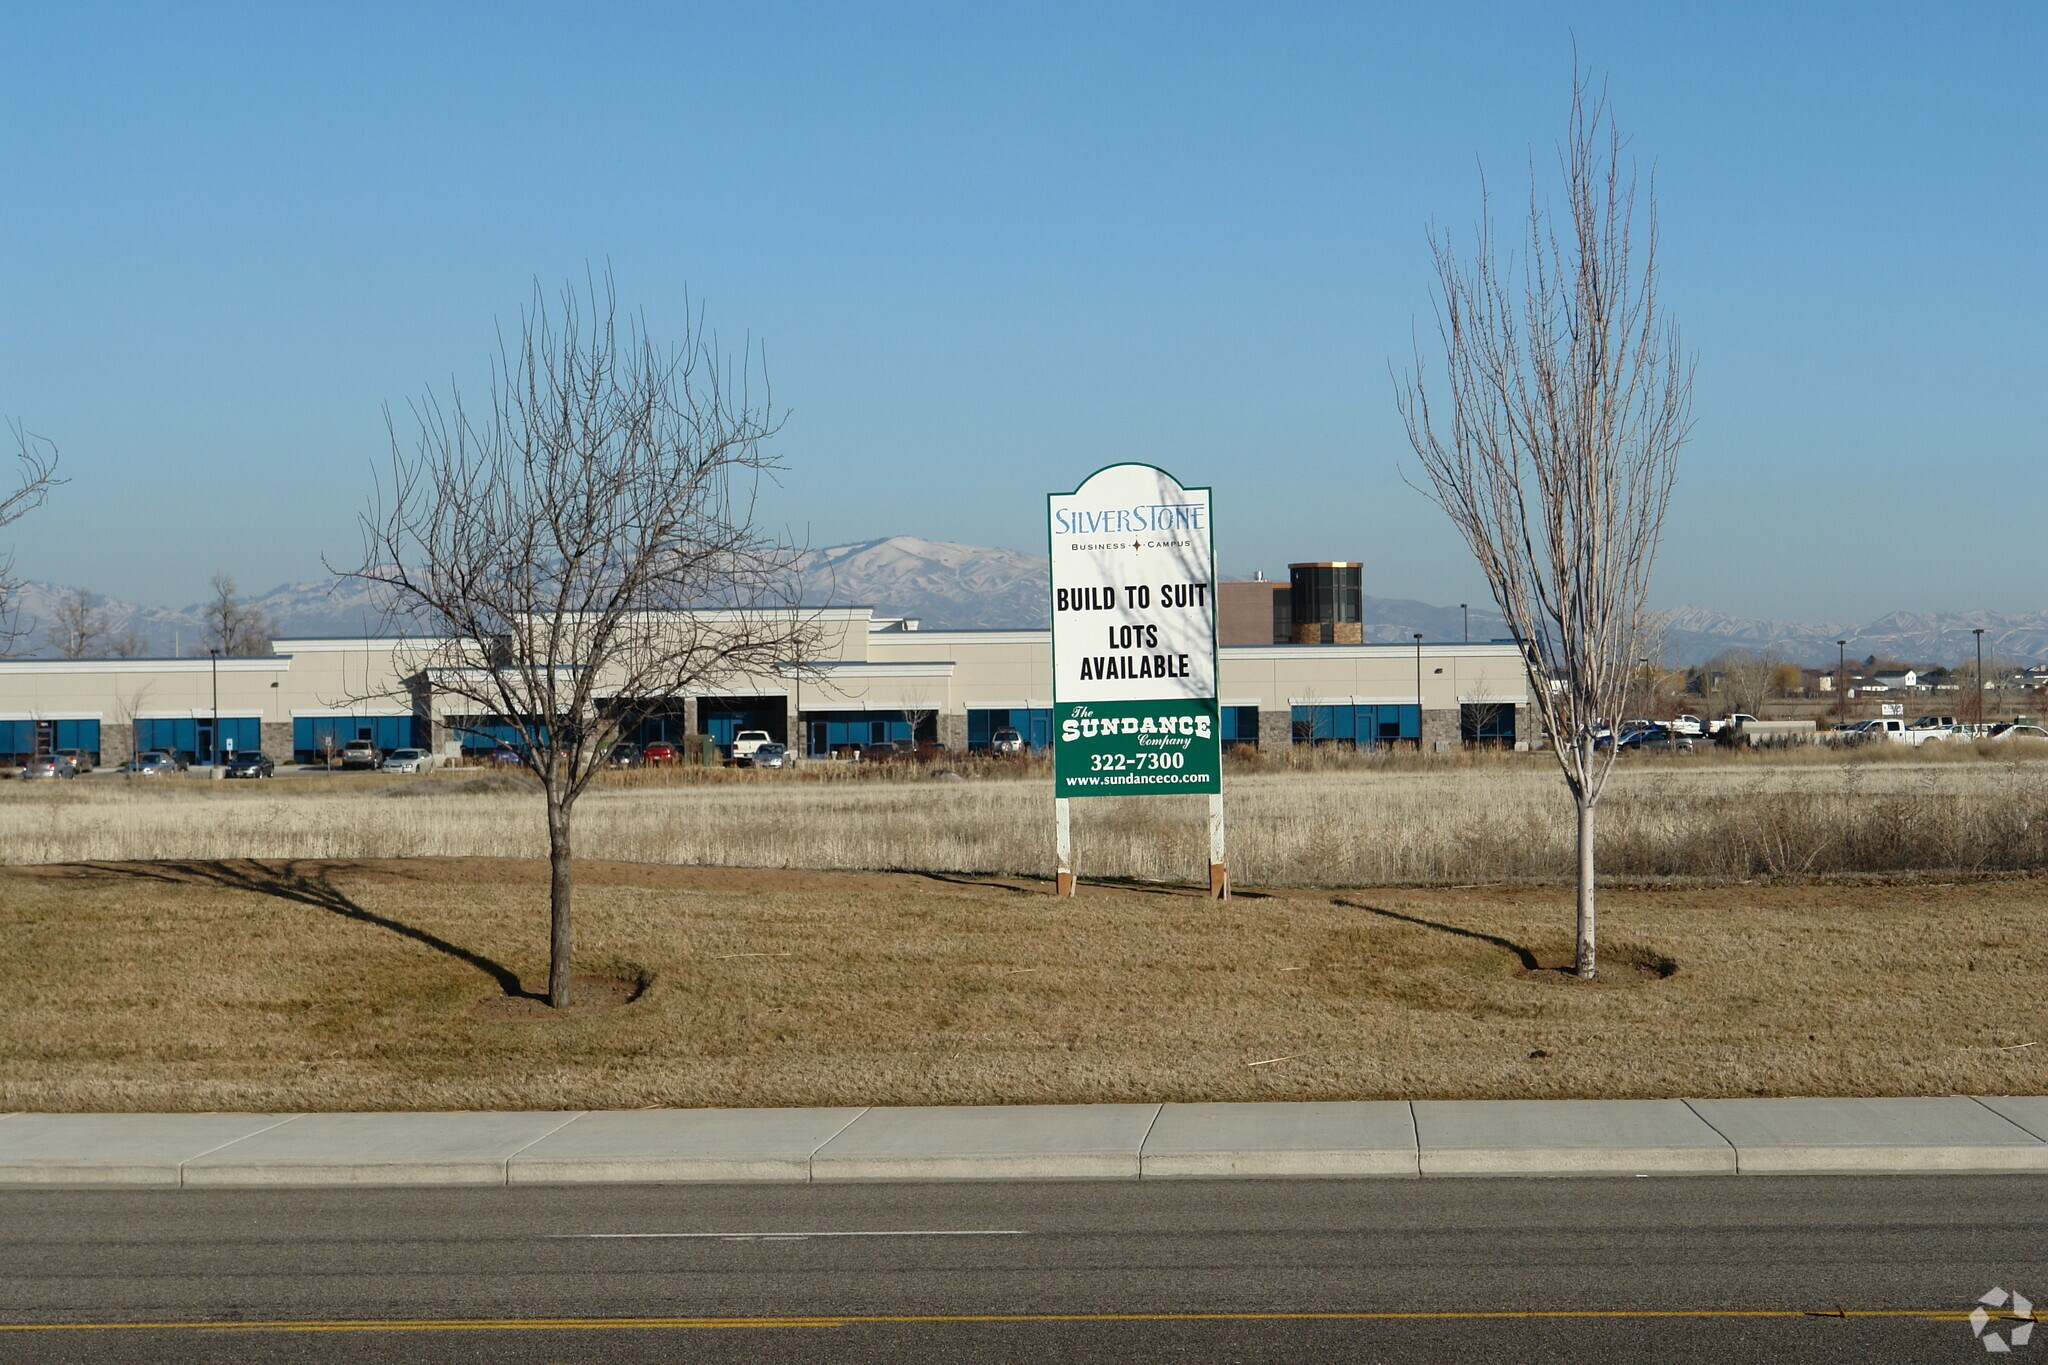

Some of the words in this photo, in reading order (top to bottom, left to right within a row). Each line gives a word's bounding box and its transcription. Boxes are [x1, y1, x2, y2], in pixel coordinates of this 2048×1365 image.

[1071, 542, 1127, 551] BUSINESS
[1147, 540, 1191, 549] CAMPUS
[1057, 586, 1115, 612] BUILD
[1124, 585, 1150, 610] TO
[1161, 583, 1207, 609] SUIT
[1109, 624, 1158, 650] LOTS
[1080, 653, 1190, 681] AVAILABLE
[1071, 705, 1094, 718] The
[1061, 715, 1211, 743] SUNDANCE
[1137, 732, 1192, 750] Company
[1090, 751, 1185, 772] 322-7300
[1066, 772, 1210, 786] www.sundanceco.com
